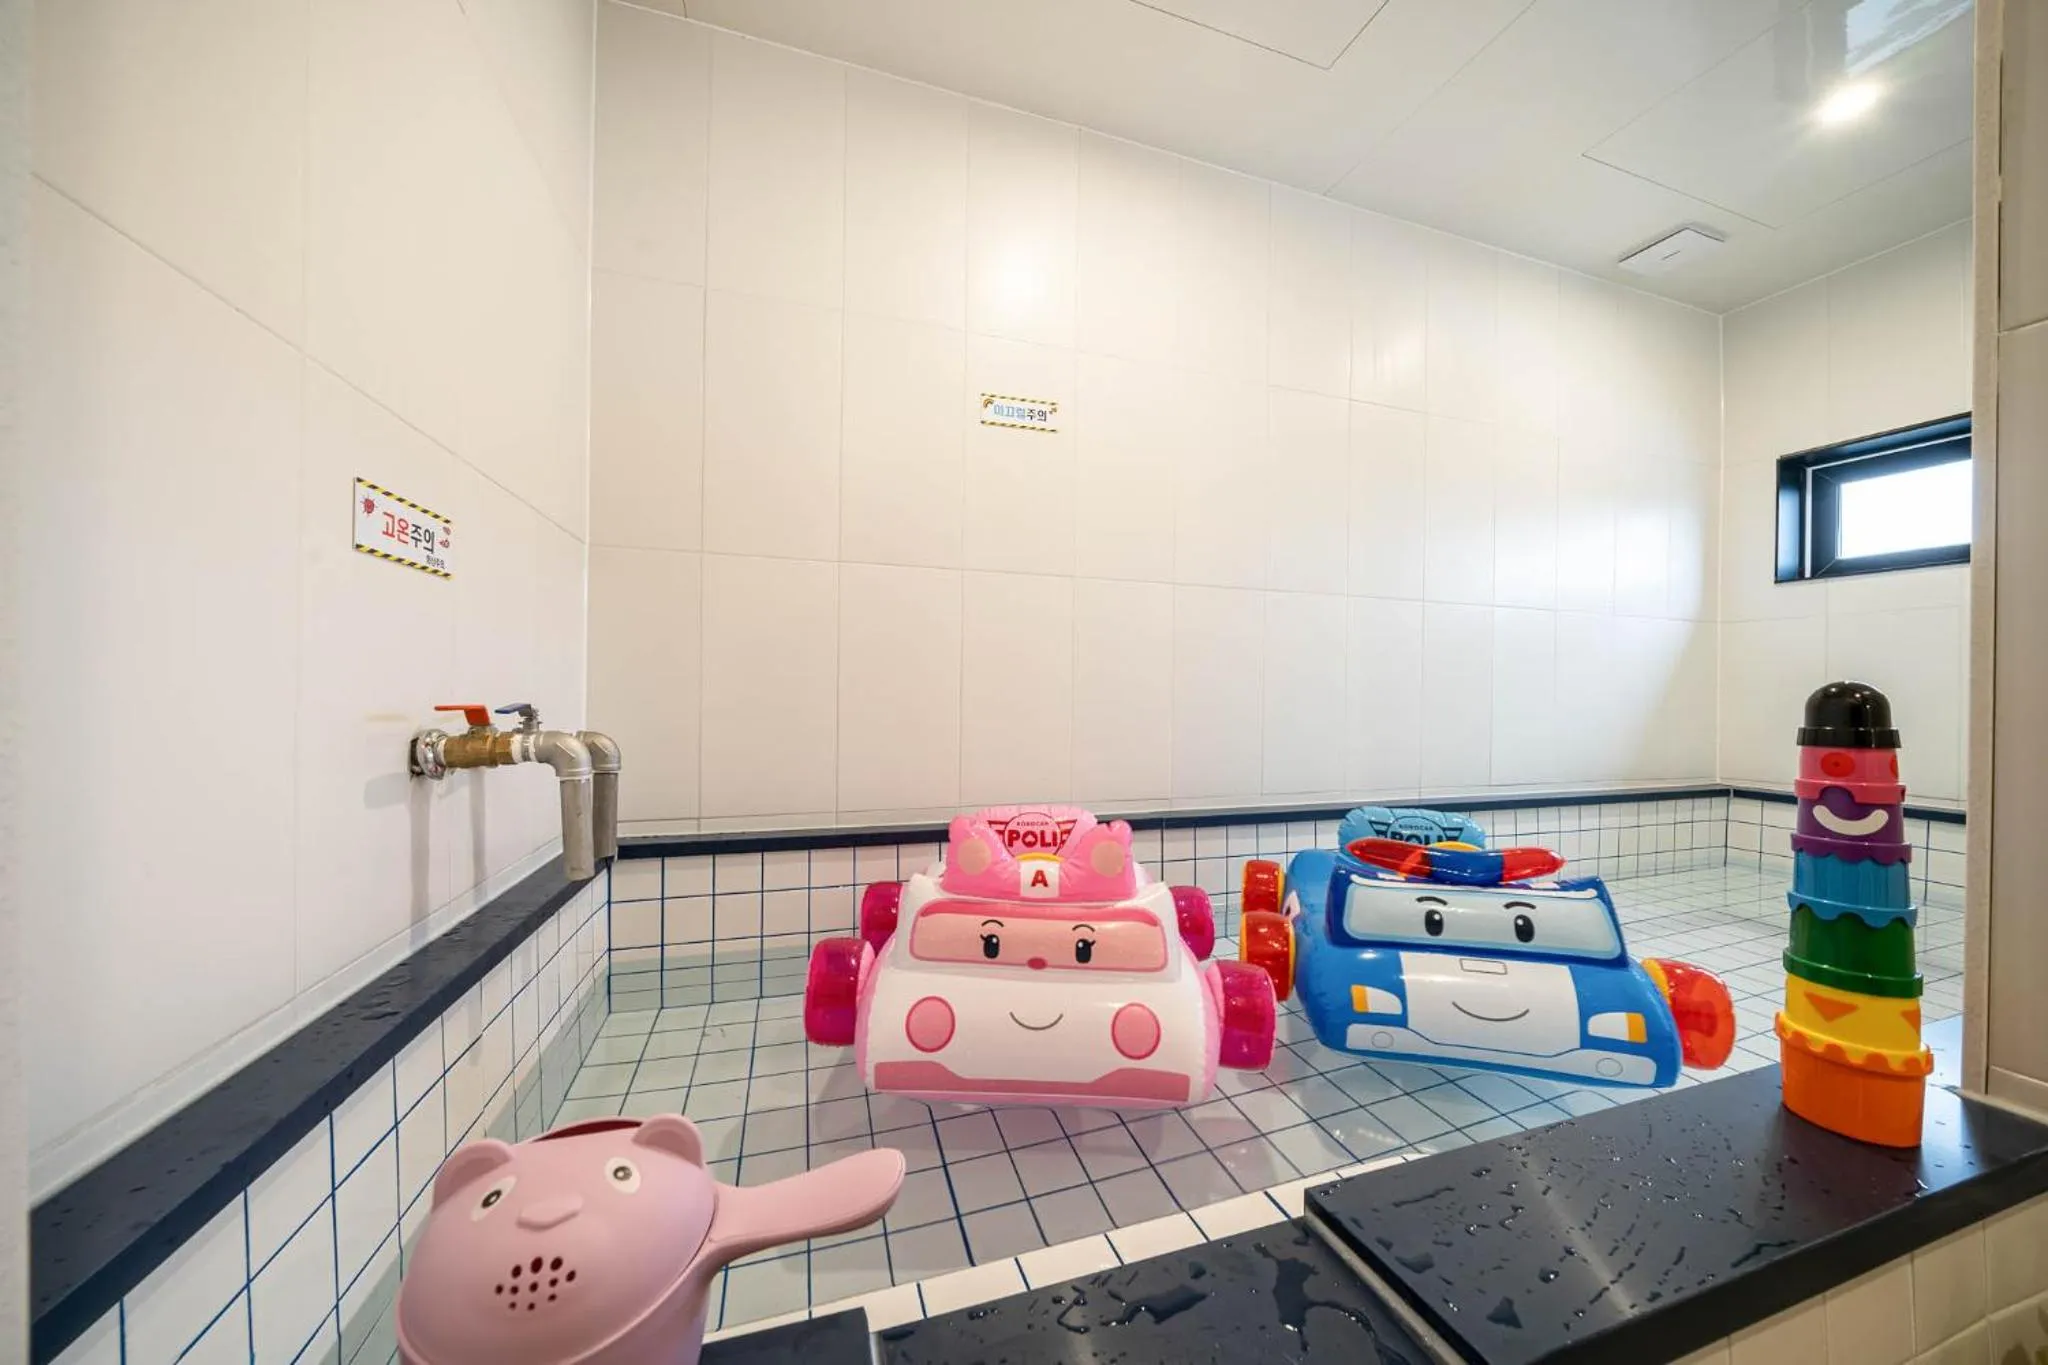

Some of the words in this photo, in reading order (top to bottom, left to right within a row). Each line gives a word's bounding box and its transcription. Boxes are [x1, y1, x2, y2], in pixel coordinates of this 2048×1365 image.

[382, 511, 435, 554] 고온주의
[1007, 829, 1058, 848] POLI
[1031, 870, 1049, 887] A
